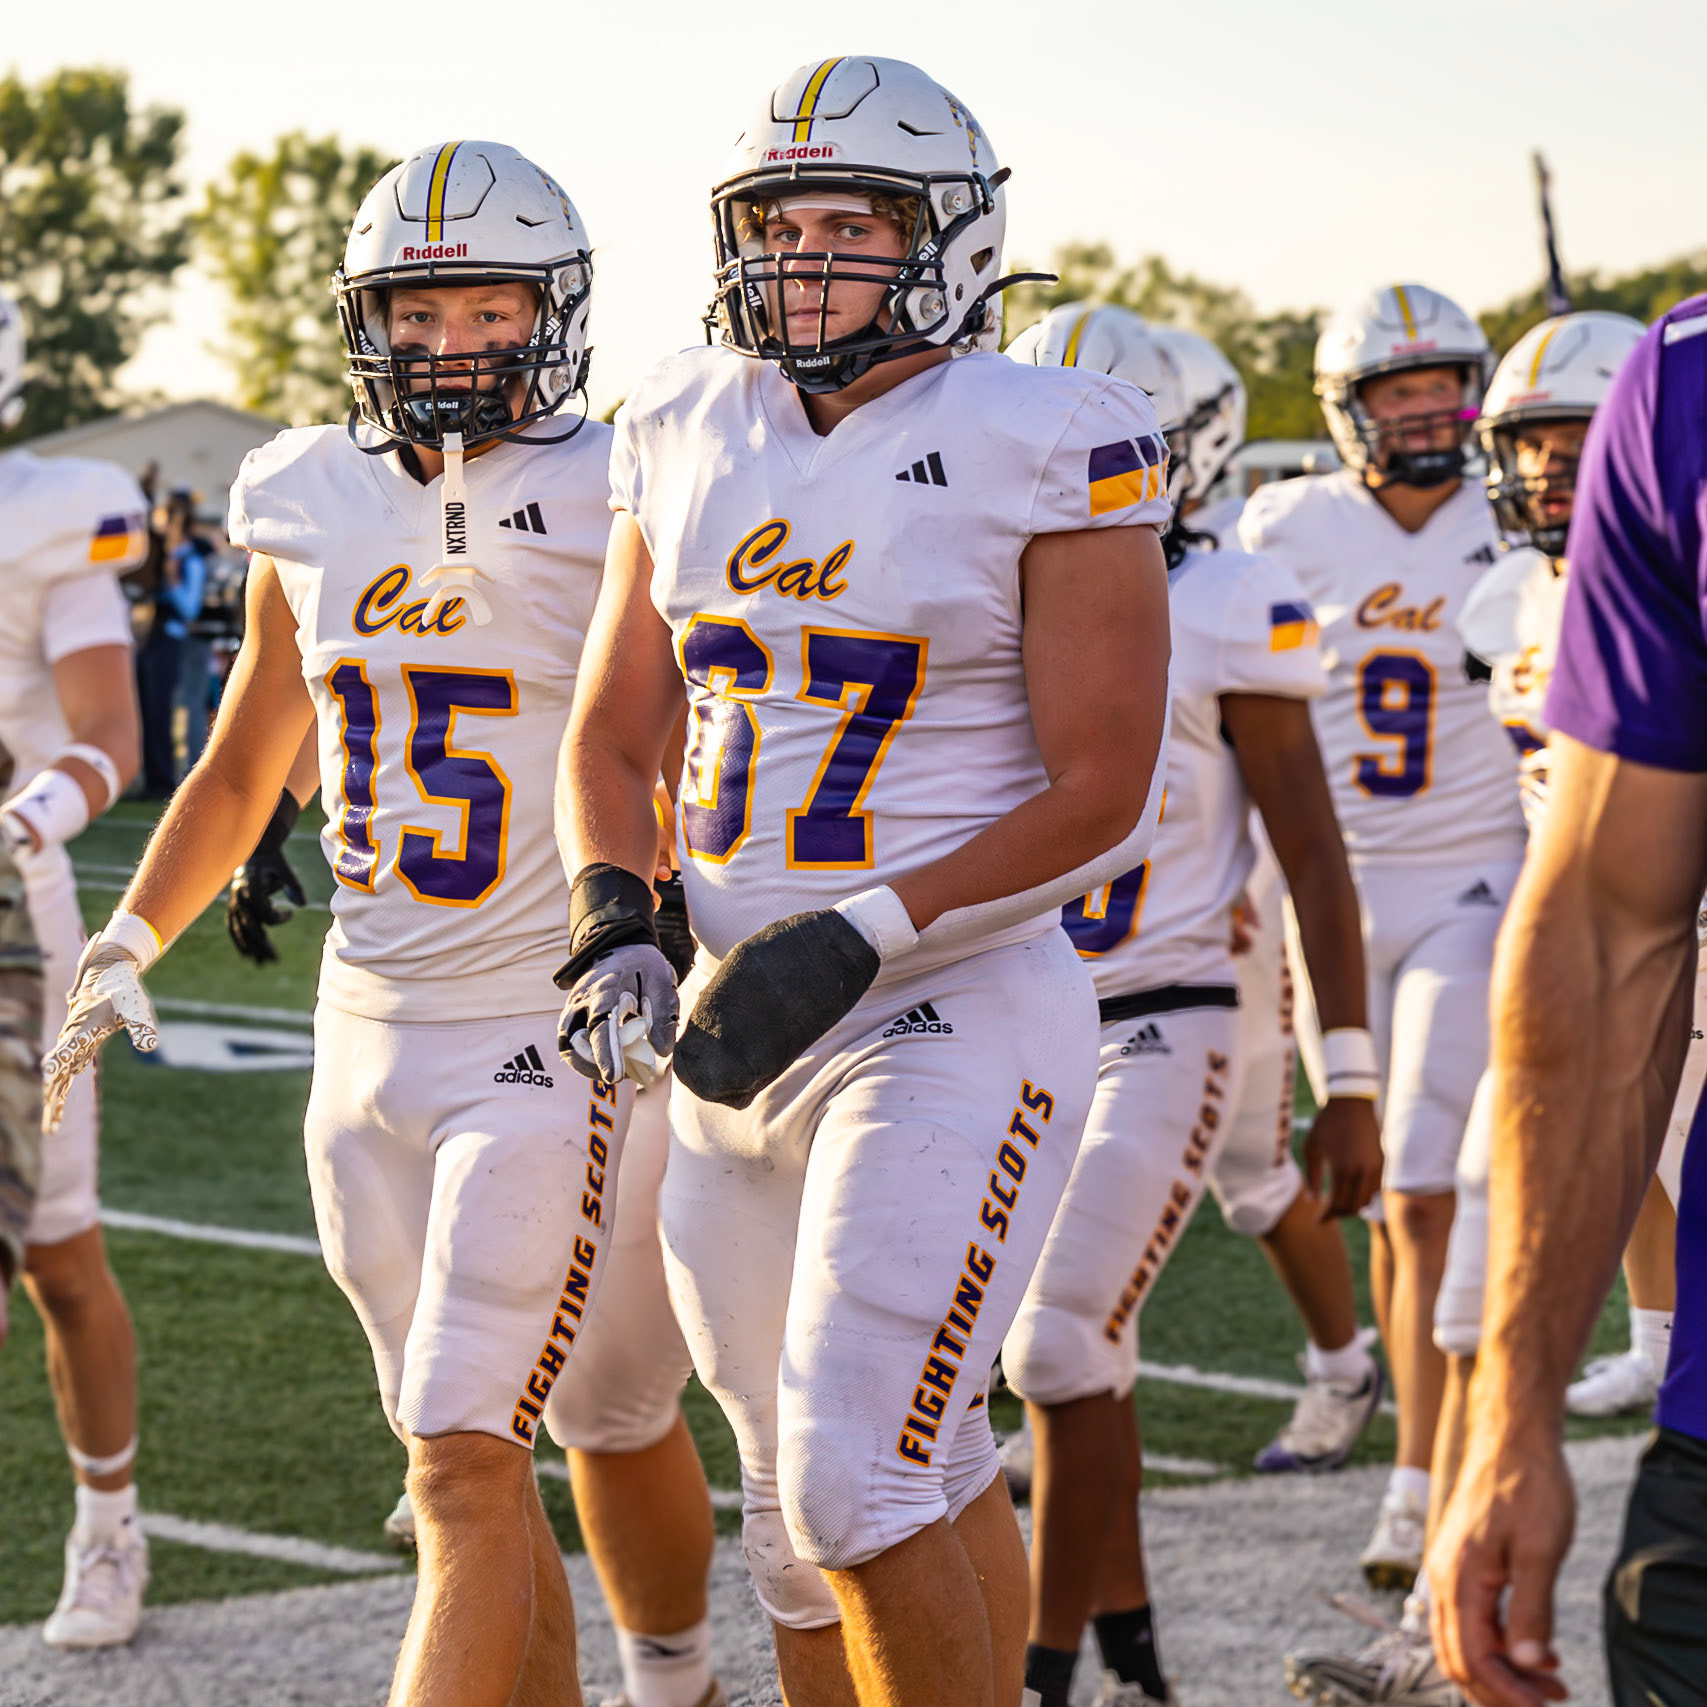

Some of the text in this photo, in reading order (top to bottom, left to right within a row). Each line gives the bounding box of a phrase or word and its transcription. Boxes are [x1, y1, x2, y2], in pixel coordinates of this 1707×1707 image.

[767, 146, 833, 161] Riddell
[403, 243, 467, 260] Riddell
[358, 329, 389, 371] Ridll
[796, 356, 831, 367] Riddell
[425, 401, 459, 410] Rdell
[445, 502, 467, 554] NXTRND
[726, 518, 855, 601] Cal
[352, 564, 466, 638] Cal
[1355, 581, 1446, 632] Cal
[678, 612, 930, 870] 67
[1350, 645, 1439, 798] 9
[323, 656, 519, 909] 15
[882, 1021, 953, 1038] adidas
[494, 1069, 554, 1088] adidas
[896, 1078, 1055, 1468] FIGHTING SCOTS
[510, 1234, 598, 1446] FIGHTING
